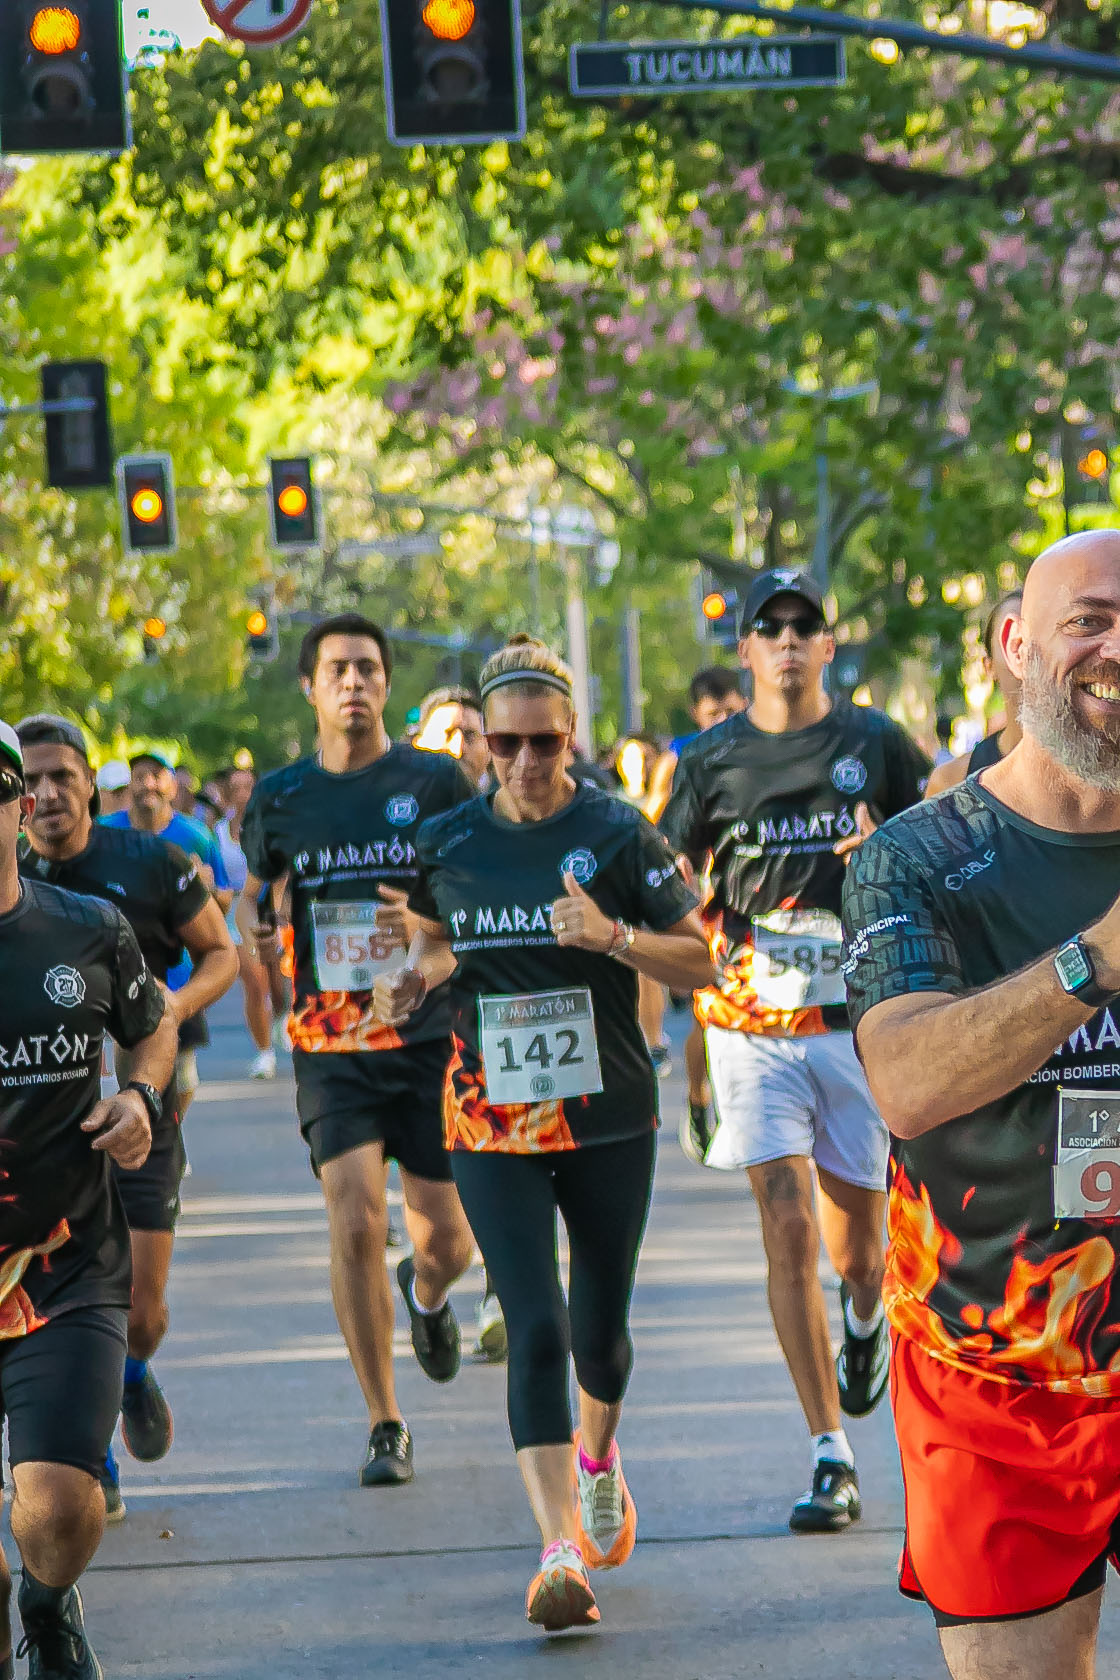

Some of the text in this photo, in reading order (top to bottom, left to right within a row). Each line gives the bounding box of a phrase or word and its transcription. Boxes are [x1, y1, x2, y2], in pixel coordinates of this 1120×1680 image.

[758, 805, 859, 845] MARATÓ
[497, 1030, 584, 1073] 142
[2, 1072, 61, 1087] VOLUNTARIOS
[1068, 1136, 1117, 1148] ASOCIACIÓN
